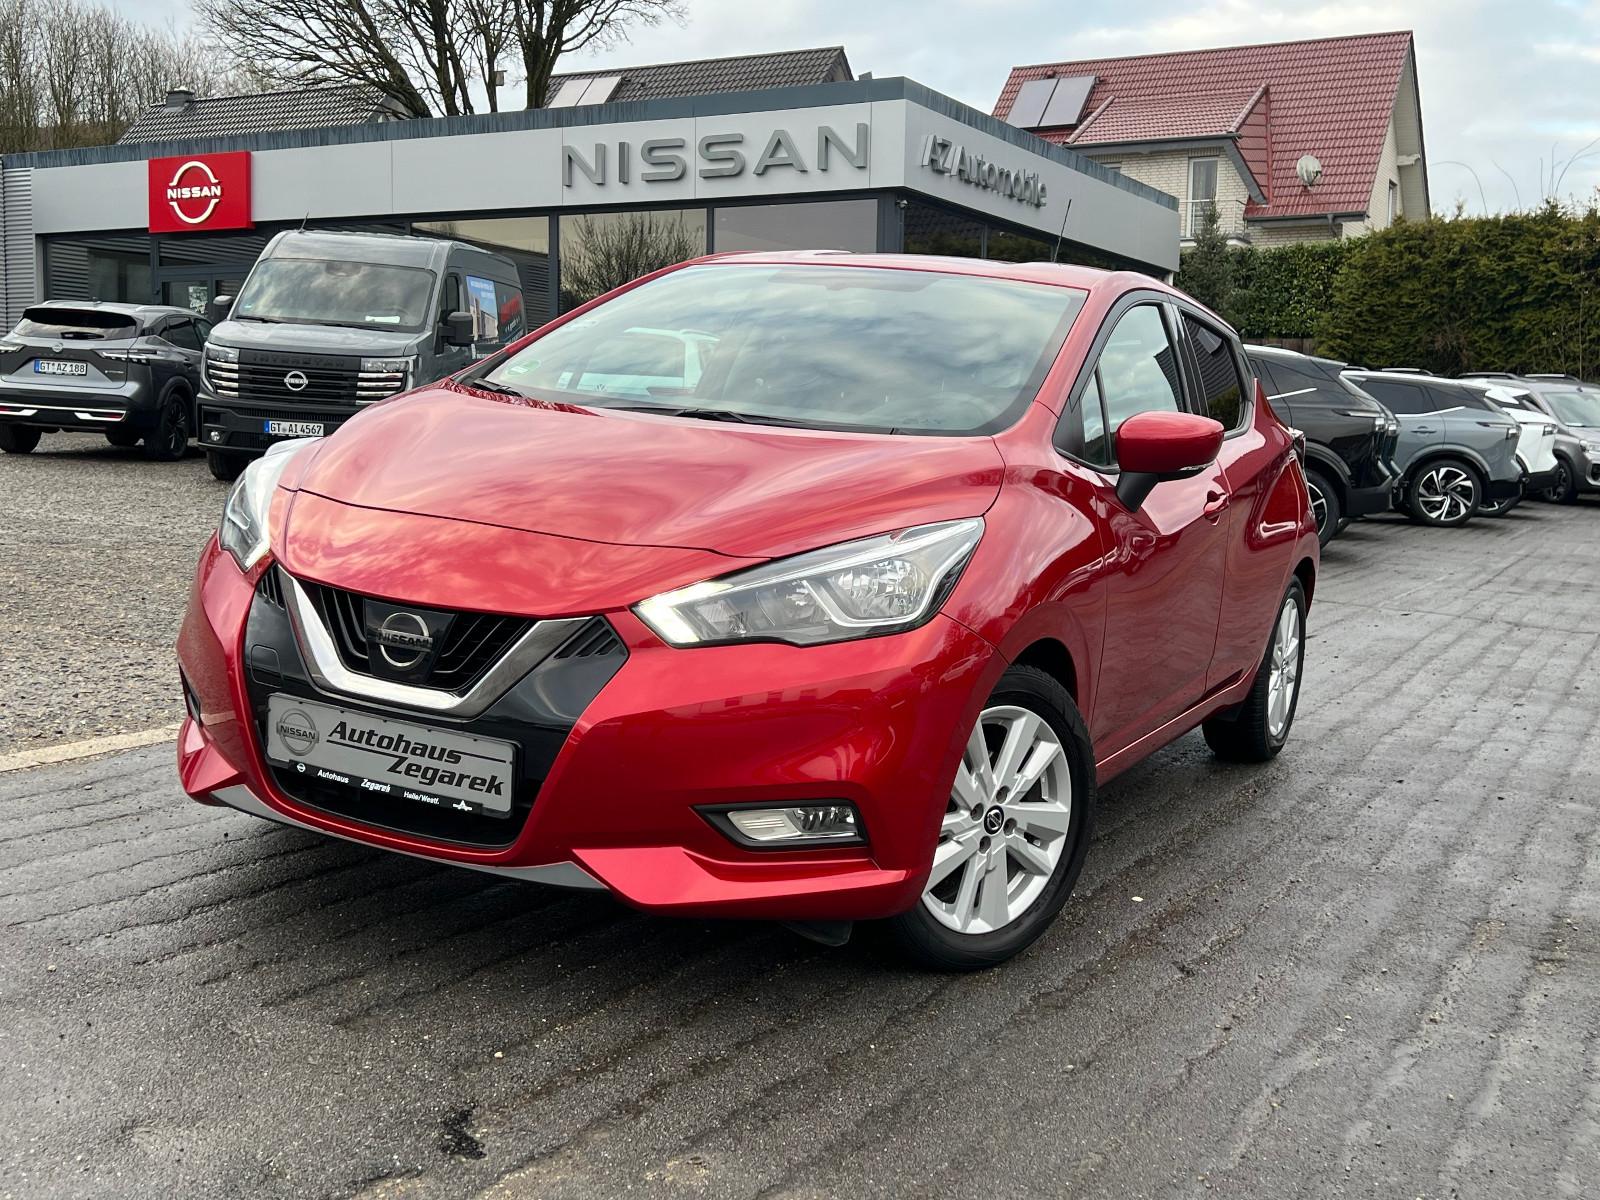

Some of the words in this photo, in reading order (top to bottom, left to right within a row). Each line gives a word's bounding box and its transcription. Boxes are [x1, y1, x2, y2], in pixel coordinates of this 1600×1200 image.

[562, 123, 868, 187] NISSAN
[949, 146, 1047, 208] Automobile
[167, 186, 221, 199] NISSAN
[40, 362, 50, 371] GT
[56, 364, 67, 372] AZ
[69, 364, 85, 373] 188
[270, 423, 281, 433] GT
[280, 725, 316, 740] NISSAN
[328, 721, 461, 765] Autohaus
[317, 769, 350, 784] Autohaus
[386, 755, 504, 796] Zegarek
